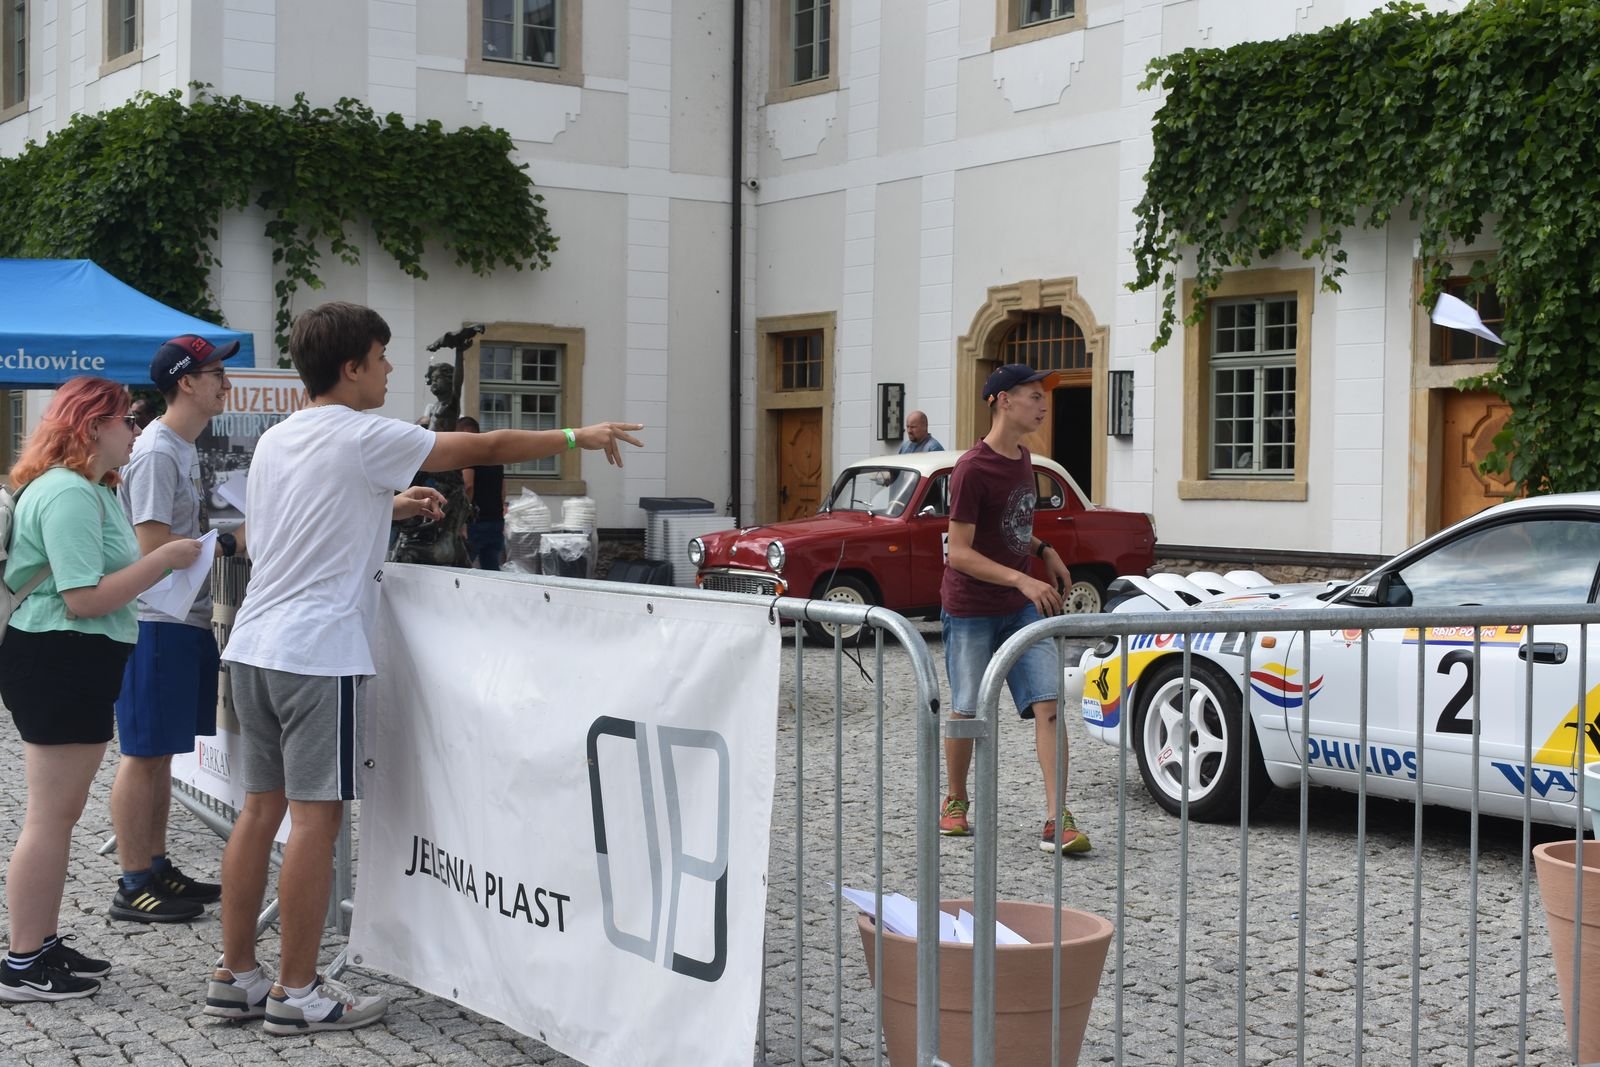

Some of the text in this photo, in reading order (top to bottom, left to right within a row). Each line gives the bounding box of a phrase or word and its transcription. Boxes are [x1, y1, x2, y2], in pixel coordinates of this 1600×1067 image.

[0, 348, 105, 370] chowice
[212, 413, 287, 437] MOTORY
[1458, 627, 1496, 637] POKI
[1436, 649, 1481, 735] 2
[1307, 737, 1418, 779] PHILIPS
[1490, 762, 1578, 798] WA
[405, 835, 571, 932] JELENIA PLAST
